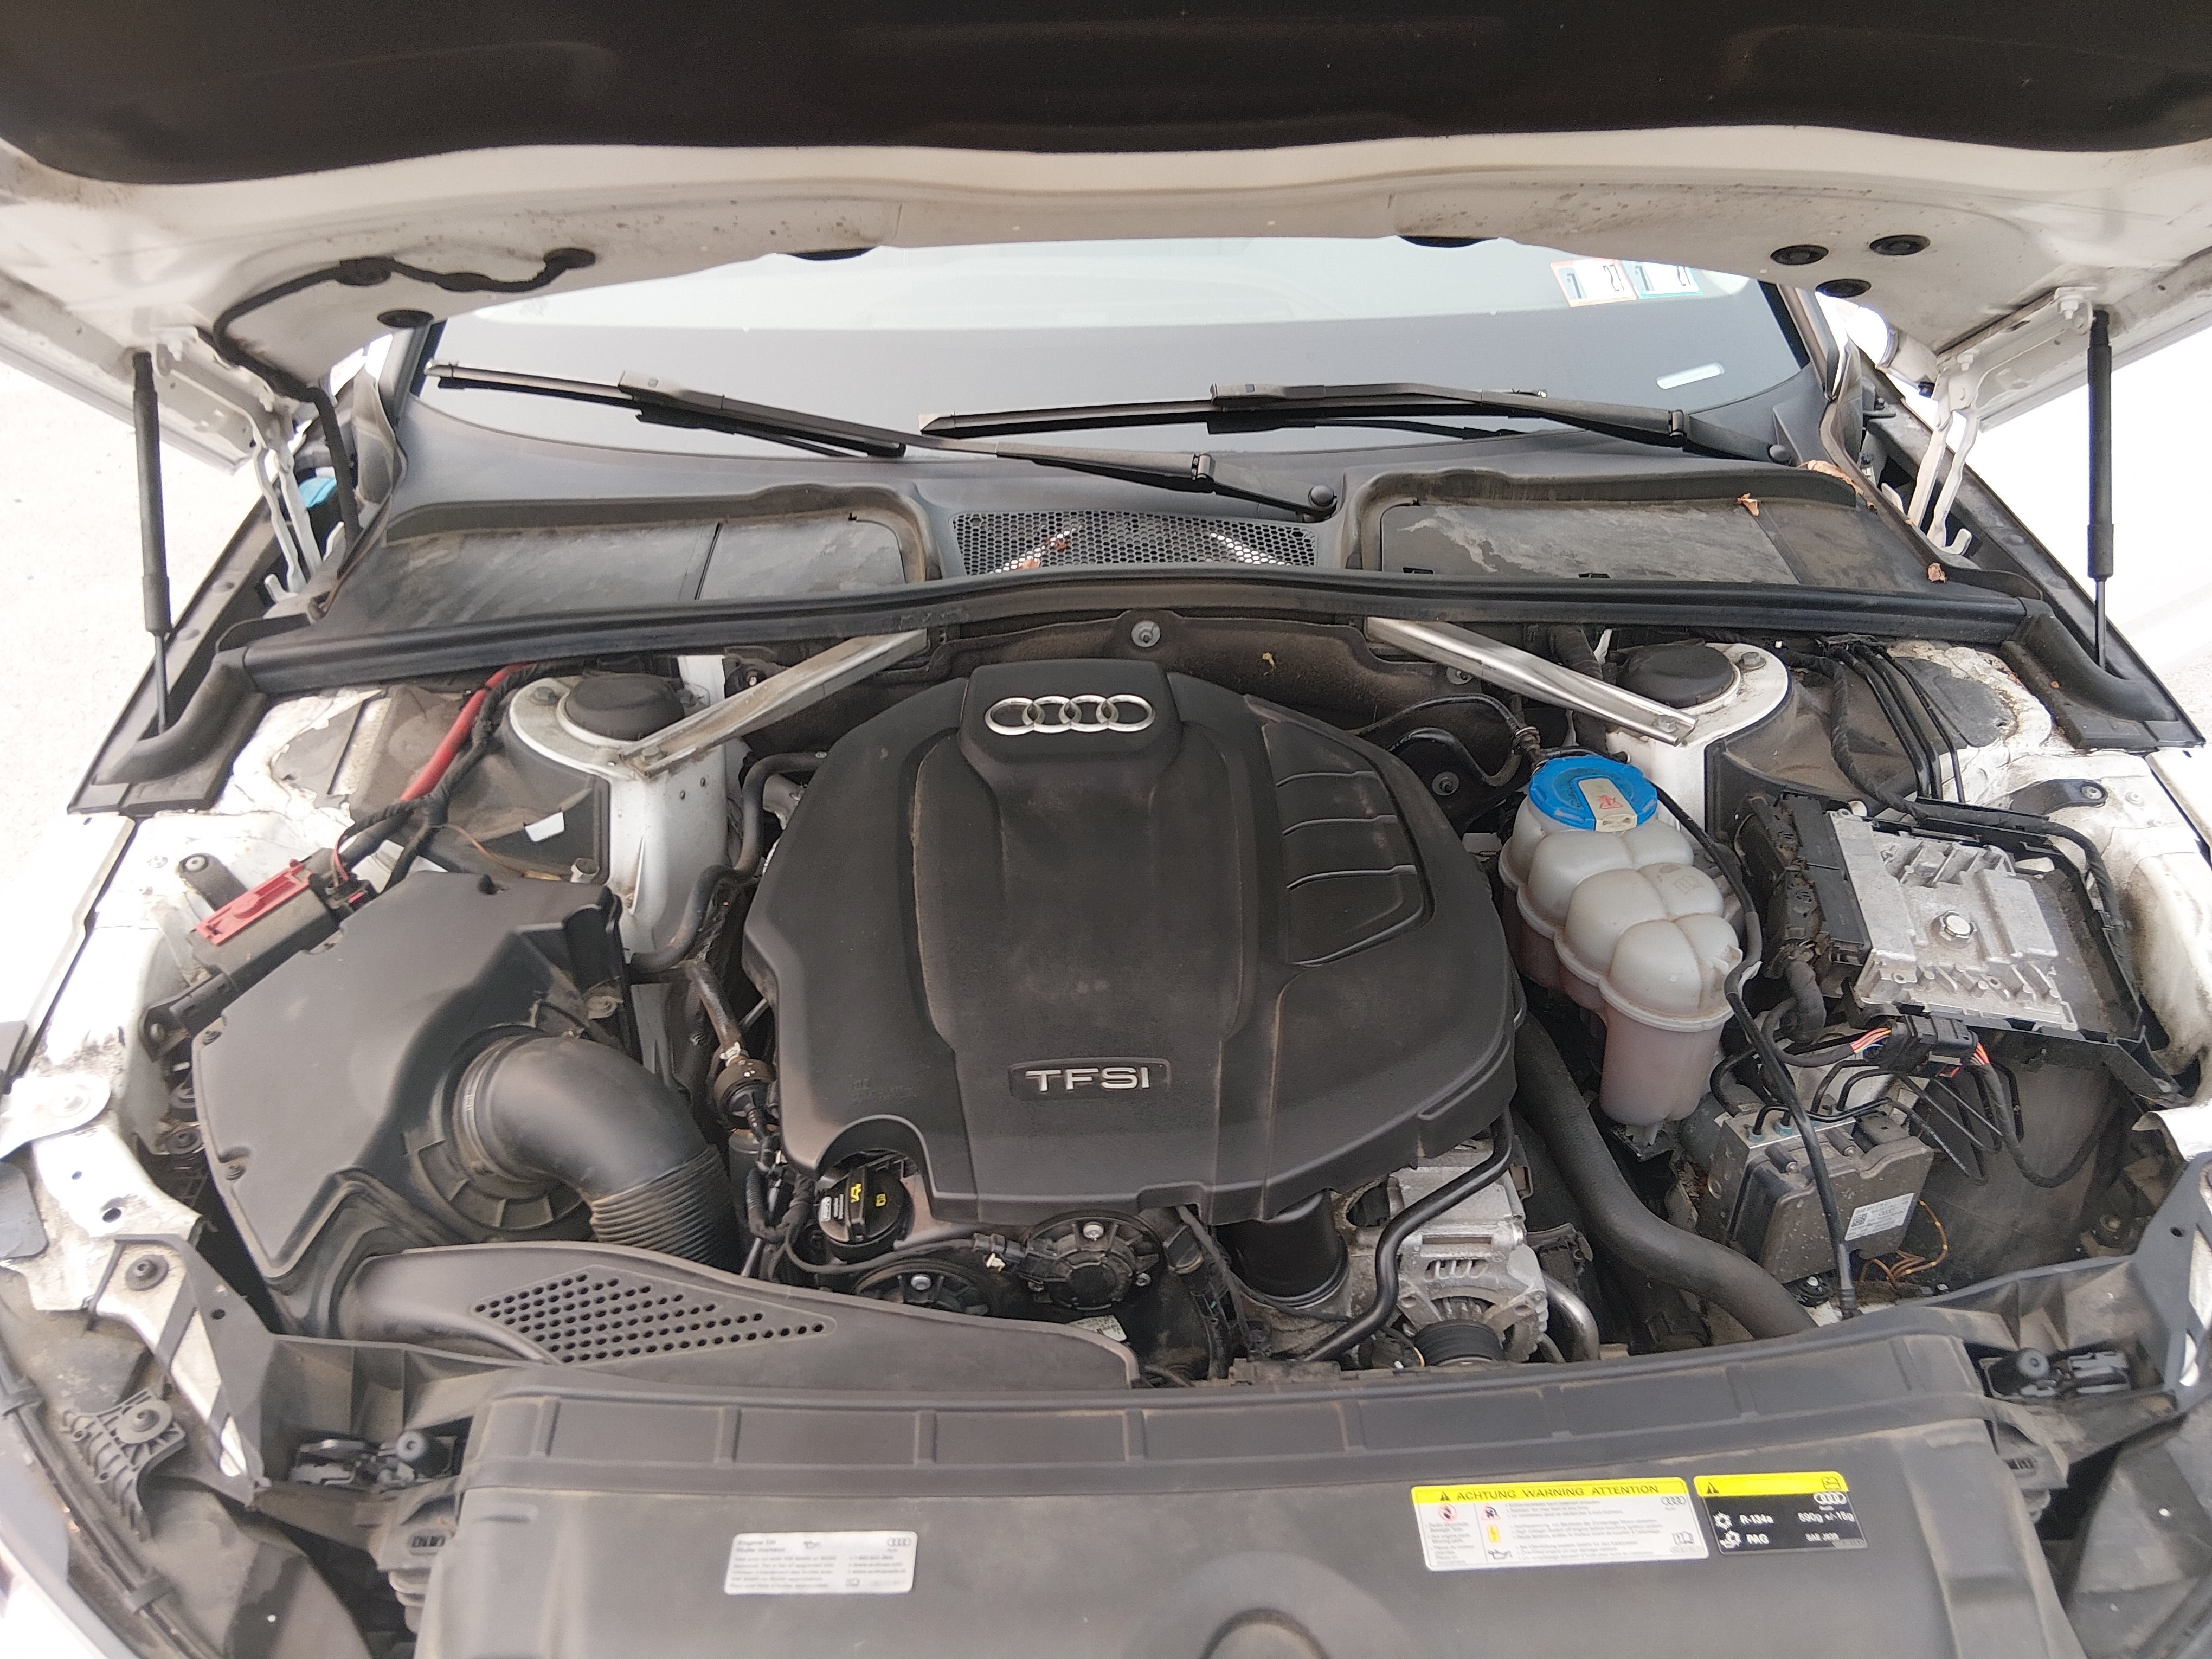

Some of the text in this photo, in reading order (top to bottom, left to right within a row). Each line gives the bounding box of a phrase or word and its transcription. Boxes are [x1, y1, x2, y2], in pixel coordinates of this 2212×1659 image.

[1025, 1066, 1150, 1092] TFSI
[1457, 1484, 1660, 1501] ACHTUNG WARNING ATTENTION
[1739, 1513, 1774, 1525] R-134a
[1746, 1533, 1770, 1545] PAG
